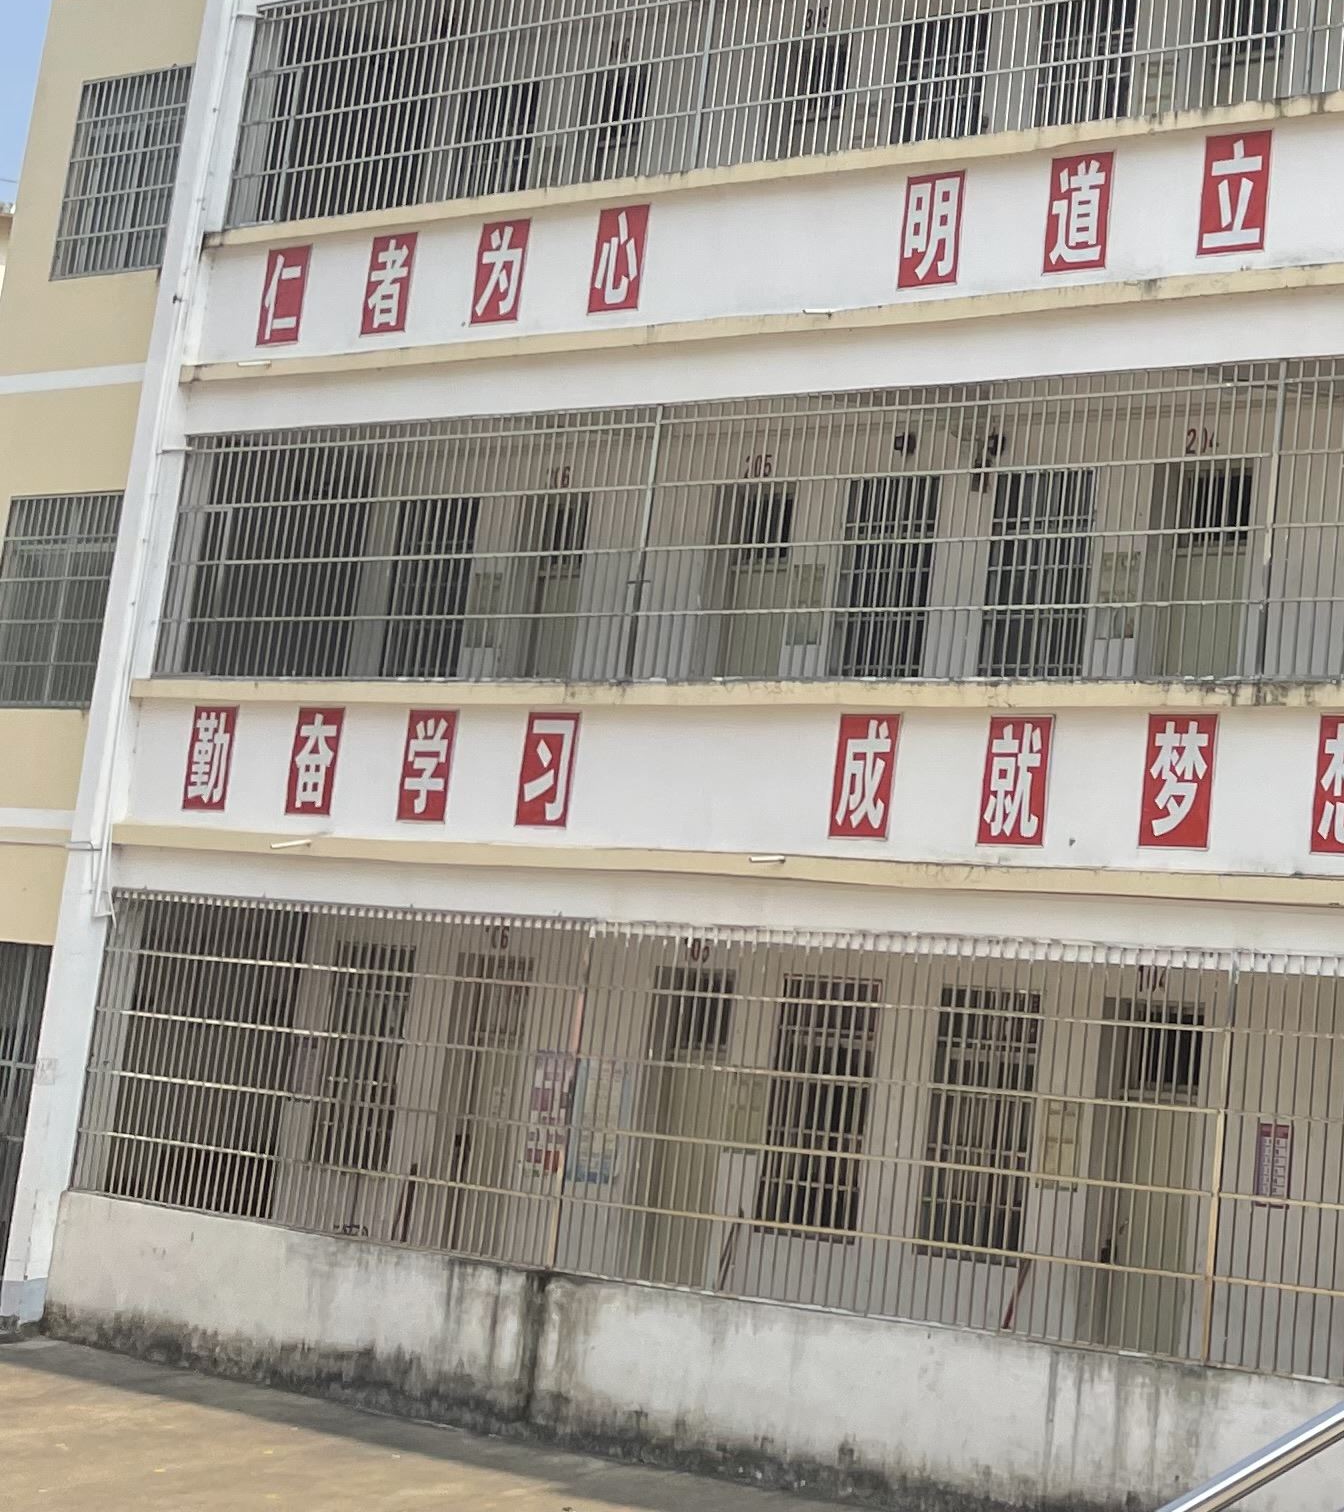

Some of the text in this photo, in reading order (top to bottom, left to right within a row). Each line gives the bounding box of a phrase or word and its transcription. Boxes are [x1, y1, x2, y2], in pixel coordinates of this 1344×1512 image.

[263, 211, 639, 342] 仁者为心
[186, 712, 575, 823] 勤奋学习
[485, 925, 509, 950] 06
